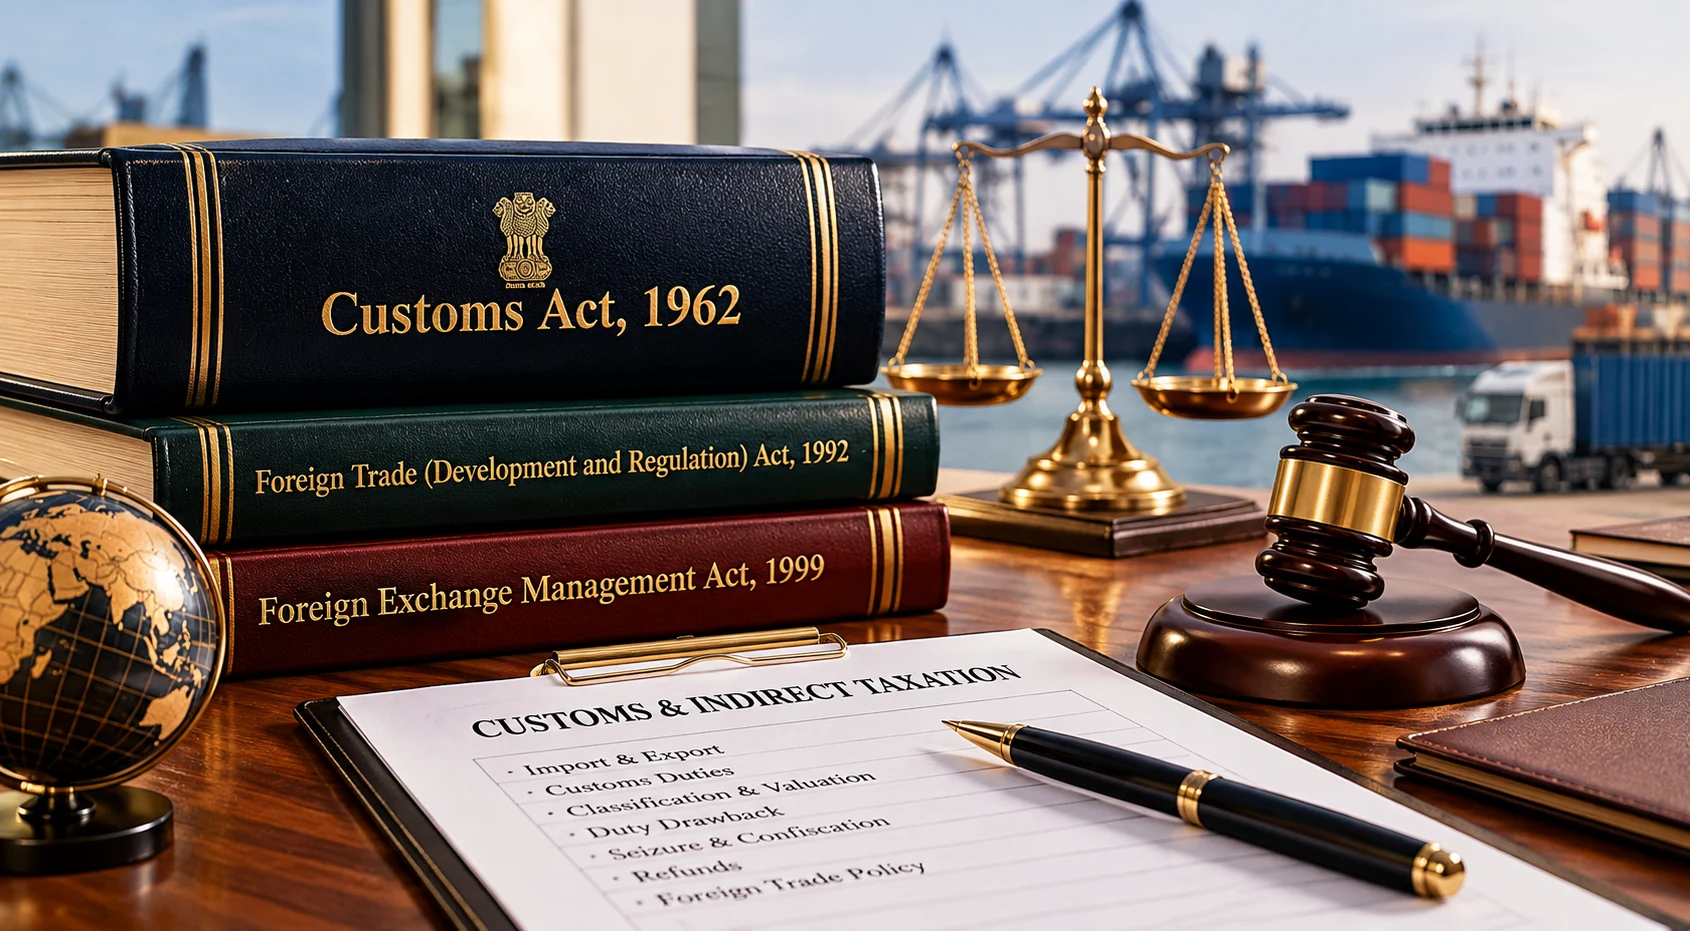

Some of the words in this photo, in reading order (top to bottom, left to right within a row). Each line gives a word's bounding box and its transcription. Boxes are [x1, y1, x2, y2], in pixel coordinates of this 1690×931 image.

[322, 290, 525, 336] Customs
[536, 282, 628, 338] Act,
[644, 283, 742, 328] 1962
[255, 468, 345, 498] Foreign
[351, 460, 418, 490] Trade
[424, 457, 577, 489] (Development
[582, 450, 622, 477] and
[627, 443, 749, 474] Regulation)
[753, 444, 796, 470] Act,
[801, 438, 850, 465] 1992
[258, 594, 370, 628] Foreign
[378, 580, 514, 617] Exchange
[520, 570, 697, 606] Management
[702, 560, 758, 592] Act,
[764, 553, 826, 585] 1999
[471, 702, 653, 739] CUSTOMS
[657, 698, 690, 718] &
[684, 680, 855, 715] INDIRECT
[852, 664, 1022, 696] TAXATION
[523, 757, 612, 776] Import
[615, 753, 639, 766] &
[641, 744, 726, 763] Export
[545, 775, 653, 797] Customs
[653, 765, 736, 785] Duties
[566, 790, 733, 818] Classification
[737, 785, 760, 798] &
[761, 771, 877, 794] Valuation
[586, 823, 650, 839] Duty
[657, 806, 786, 832] Drawback
[608, 839, 704, 861] Seizure
[708, 836, 734, 849] &
[736, 817, 891, 845] Confiscation
[631, 860, 743, 884] Refunds
[655, 884, 762, 908] Foreign
[763, 872, 844, 892] Trade
[846, 861, 926, 880] Policy
